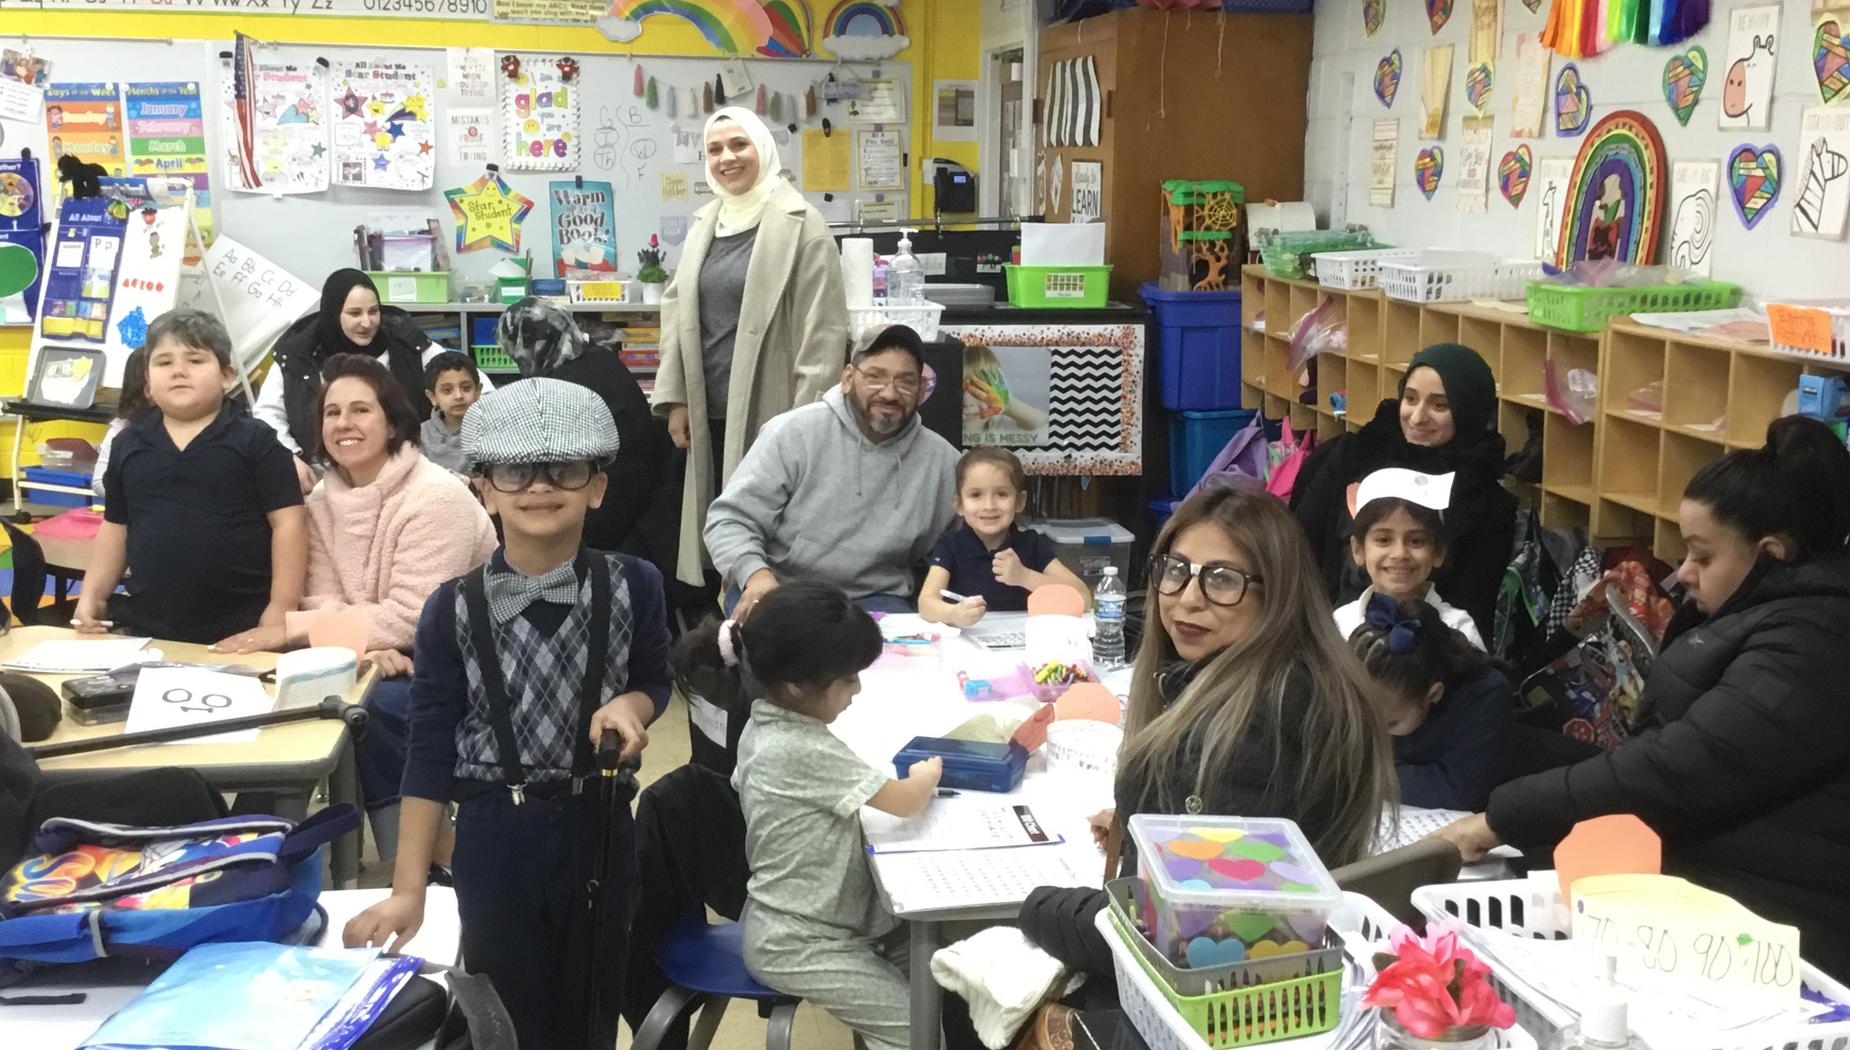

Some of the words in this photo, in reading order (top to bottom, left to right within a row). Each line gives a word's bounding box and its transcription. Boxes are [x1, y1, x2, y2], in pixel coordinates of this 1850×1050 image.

[355, 62, 367, 70] All
[372, 70, 416, 81] Student
[140, 101, 190, 117] January
[515, 86, 568, 118] glad
[538, 111, 555, 124] you
[628, 106, 642, 124] B
[515, 131, 568, 158] here
[155, 157, 183, 170] April
[554, 190, 606, 206] Warm
[1072, 189, 1099, 217] LEARN
[468, 200, 494, 213] Star
[69, 213, 82, 221] All
[557, 211, 606, 229] Good
[240, 258, 256, 275] Bb
[278, 279, 297, 298] Dd
[963, 433, 981, 443] NG
[985, 433, 995, 443] IS
[999, 433, 1038, 443] MESSY
[1637, 925, 1678, 973] 80
[1693, 933, 1732, 981] 90
[1752, 941, 1794, 987] 100
